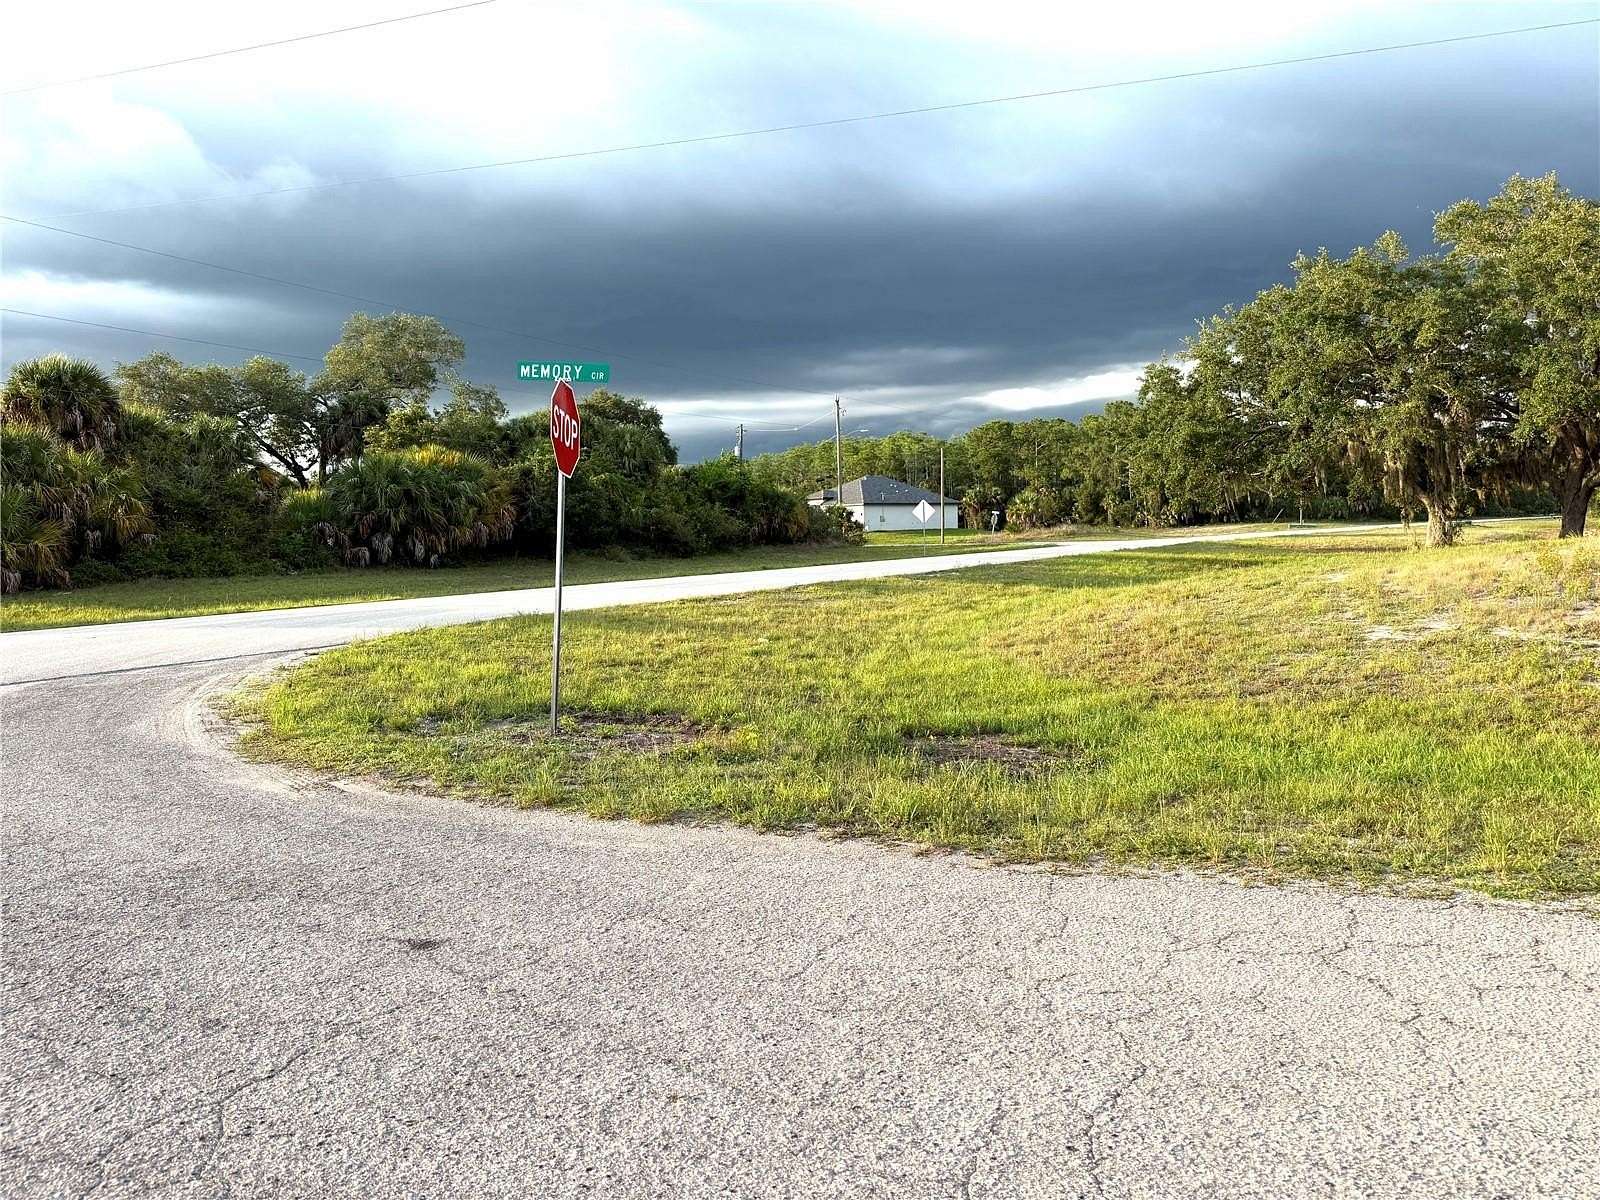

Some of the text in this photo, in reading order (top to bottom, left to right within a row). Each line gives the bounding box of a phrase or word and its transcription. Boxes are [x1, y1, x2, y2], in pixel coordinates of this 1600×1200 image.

[520, 364, 605, 380] MEMORY CIR
[553, 405, 578, 450] STOP
